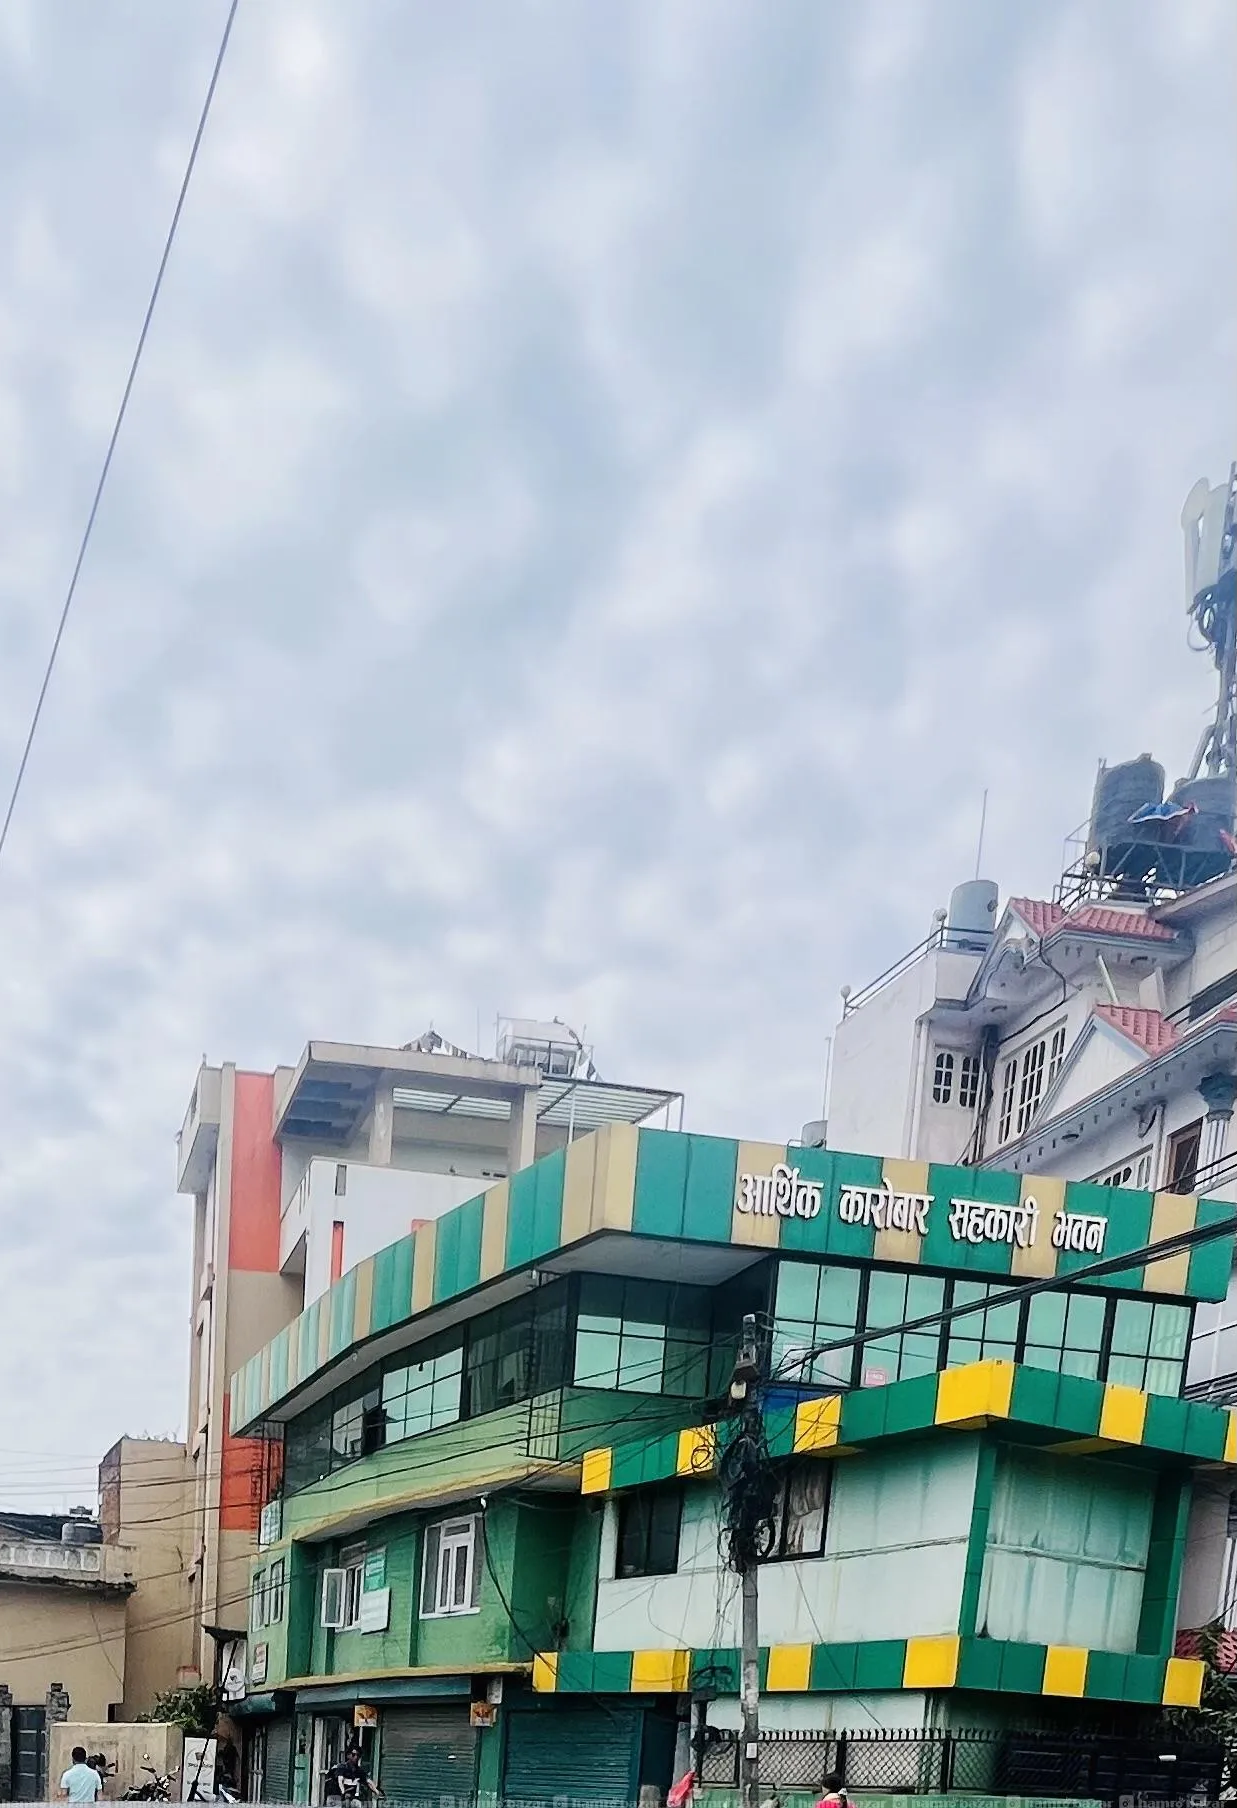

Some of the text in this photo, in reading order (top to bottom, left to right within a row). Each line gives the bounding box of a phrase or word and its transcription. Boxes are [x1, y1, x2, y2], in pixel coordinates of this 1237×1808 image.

[737, 1163, 1108, 1254] आर्थिक कारोबार सहकारी भवन
